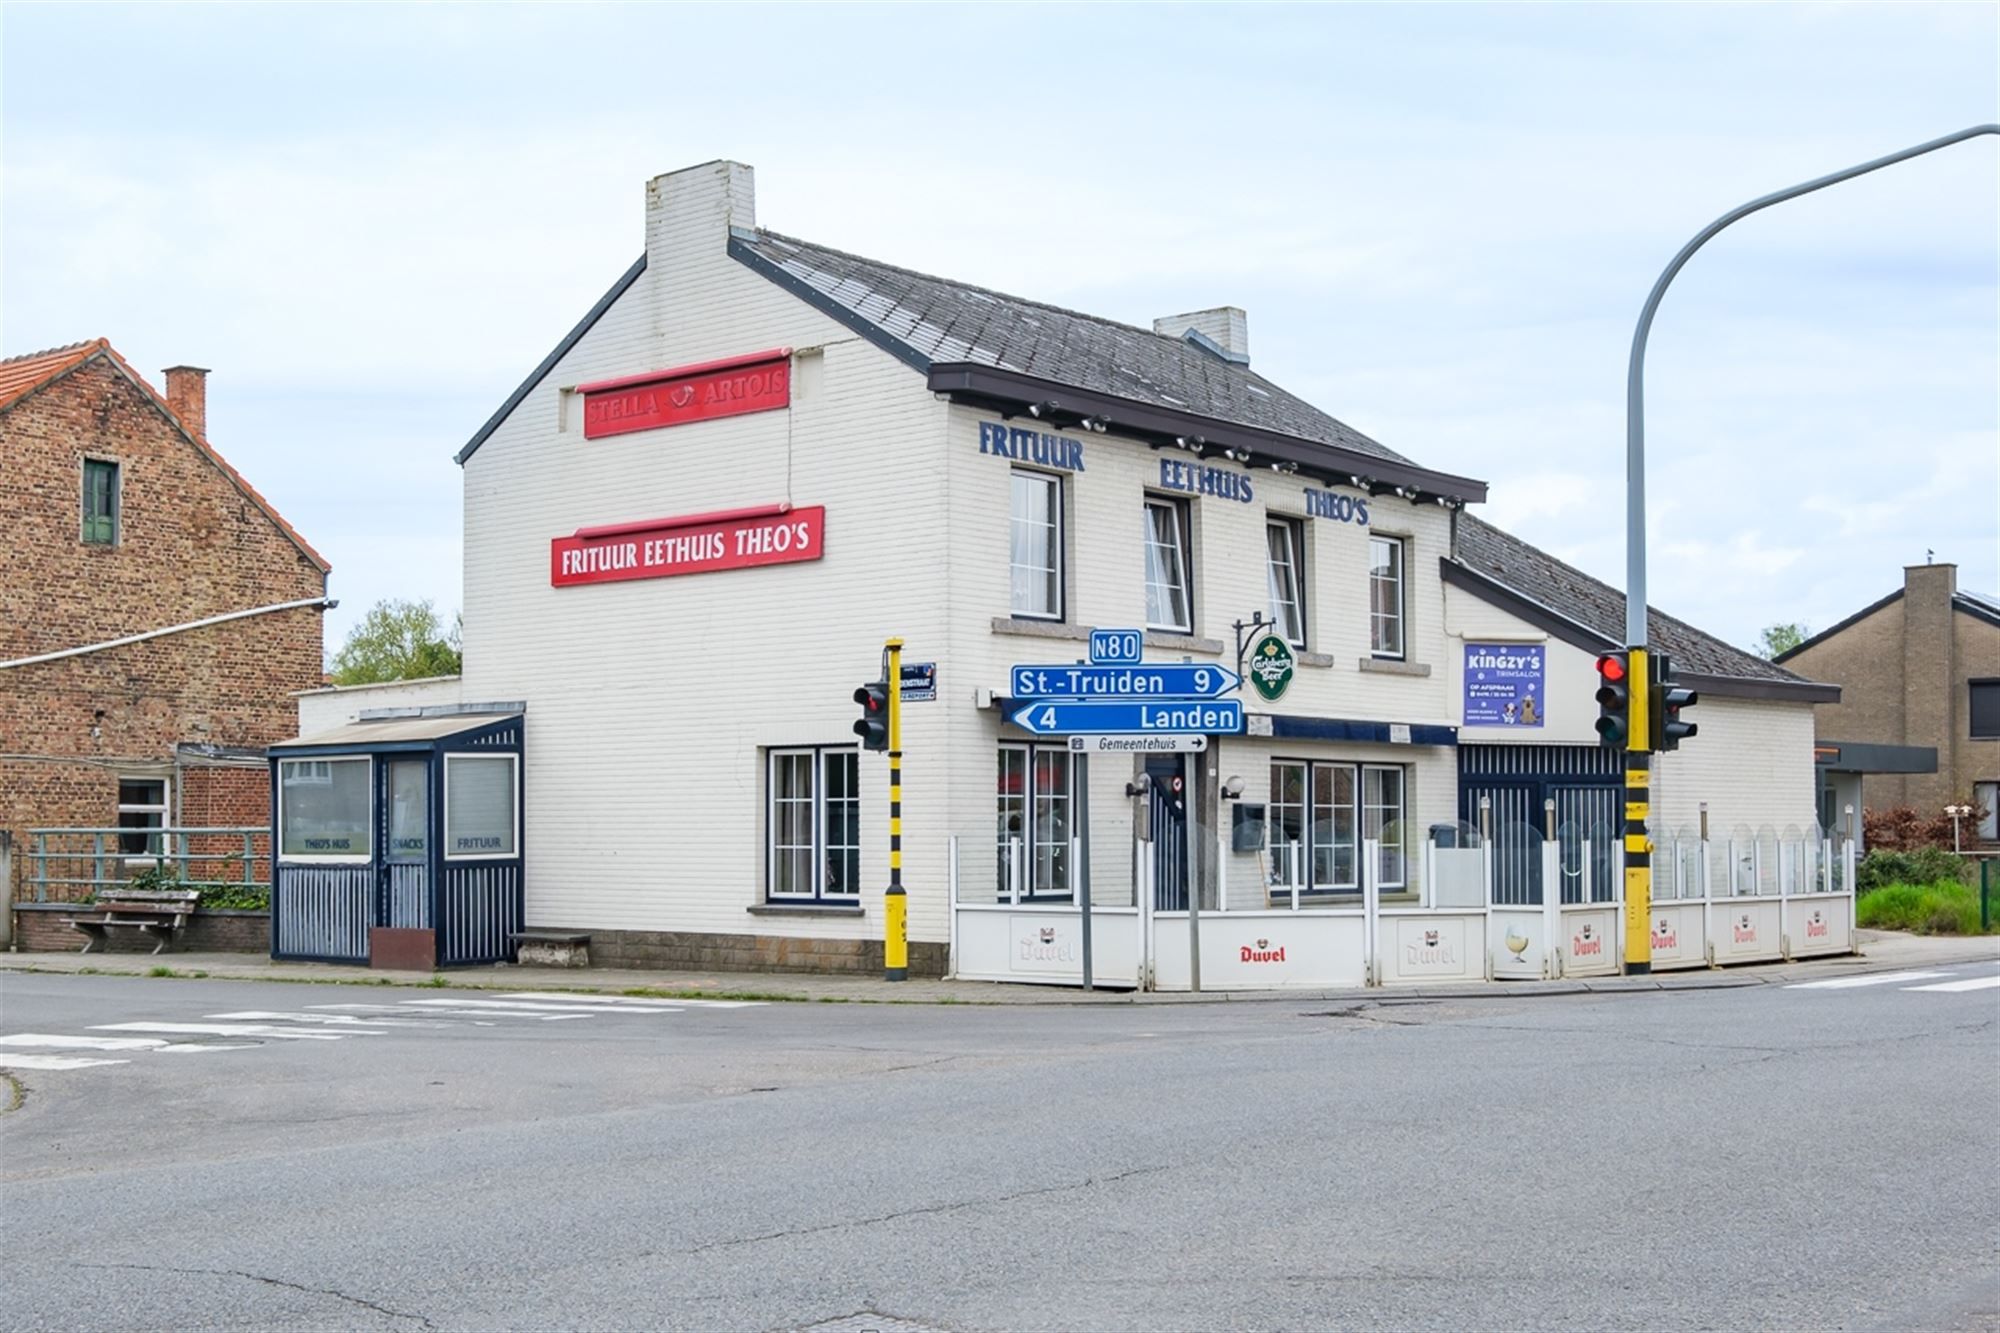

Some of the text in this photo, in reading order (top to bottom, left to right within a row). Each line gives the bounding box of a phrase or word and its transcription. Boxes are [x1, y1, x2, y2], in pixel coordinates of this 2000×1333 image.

[588, 370, 786, 424] STELLA ARTOIS
[978, 420, 1370, 526] FRITUUR EETHUIS THEO'S
[562, 522, 809, 576] FRITUUR EETHUIS THEO'S
[1095, 635, 1137, 658] N80
[1019, 669, 1210, 694] St.-Truiden 9
[1040, 707, 1057, 729] 4
[1141, 705, 1234, 729] Landen
[1099, 737, 1176, 750] Gemeentehuis
[304, 838, 350, 849] THEO'S HUIS
[392, 838, 424, 849] SNACKS
[457, 837, 502, 848] FRITUUR
[1734, 925, 1757, 943] Duvel
[1807, 920, 1828, 938] Duvel
[1573, 935, 1601, 956] Duvel
[1651, 930, 1677, 950] Duvel
[1020, 939, 1075, 962] Duvel
[1241, 946, 1286, 963] Duvel
